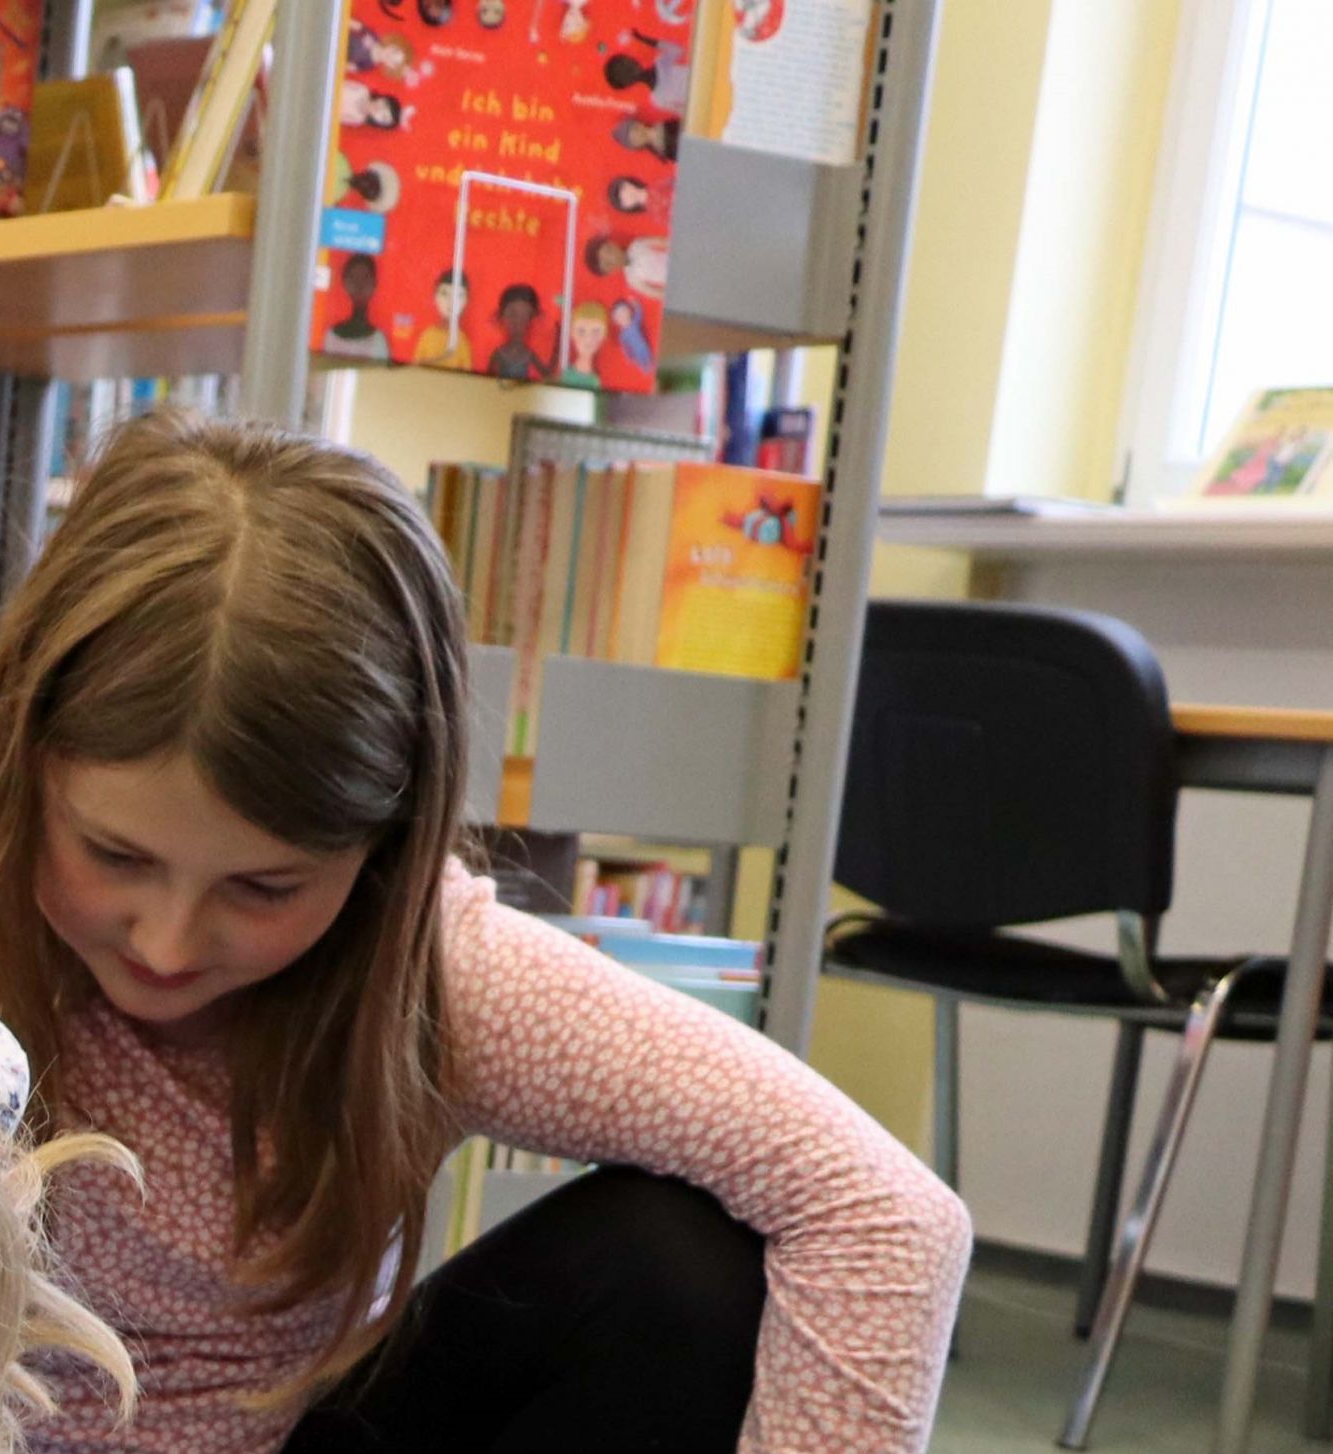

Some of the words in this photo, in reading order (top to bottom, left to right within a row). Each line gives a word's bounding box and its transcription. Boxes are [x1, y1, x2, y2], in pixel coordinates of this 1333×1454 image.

[461, 88, 501, 116] Ich
[511, 94, 554, 122] bin
[447, 124, 488, 150] ein
[499, 130, 561, 165] Kind
[414, 162, 465, 188] und
[457, 199, 541, 238] echte
